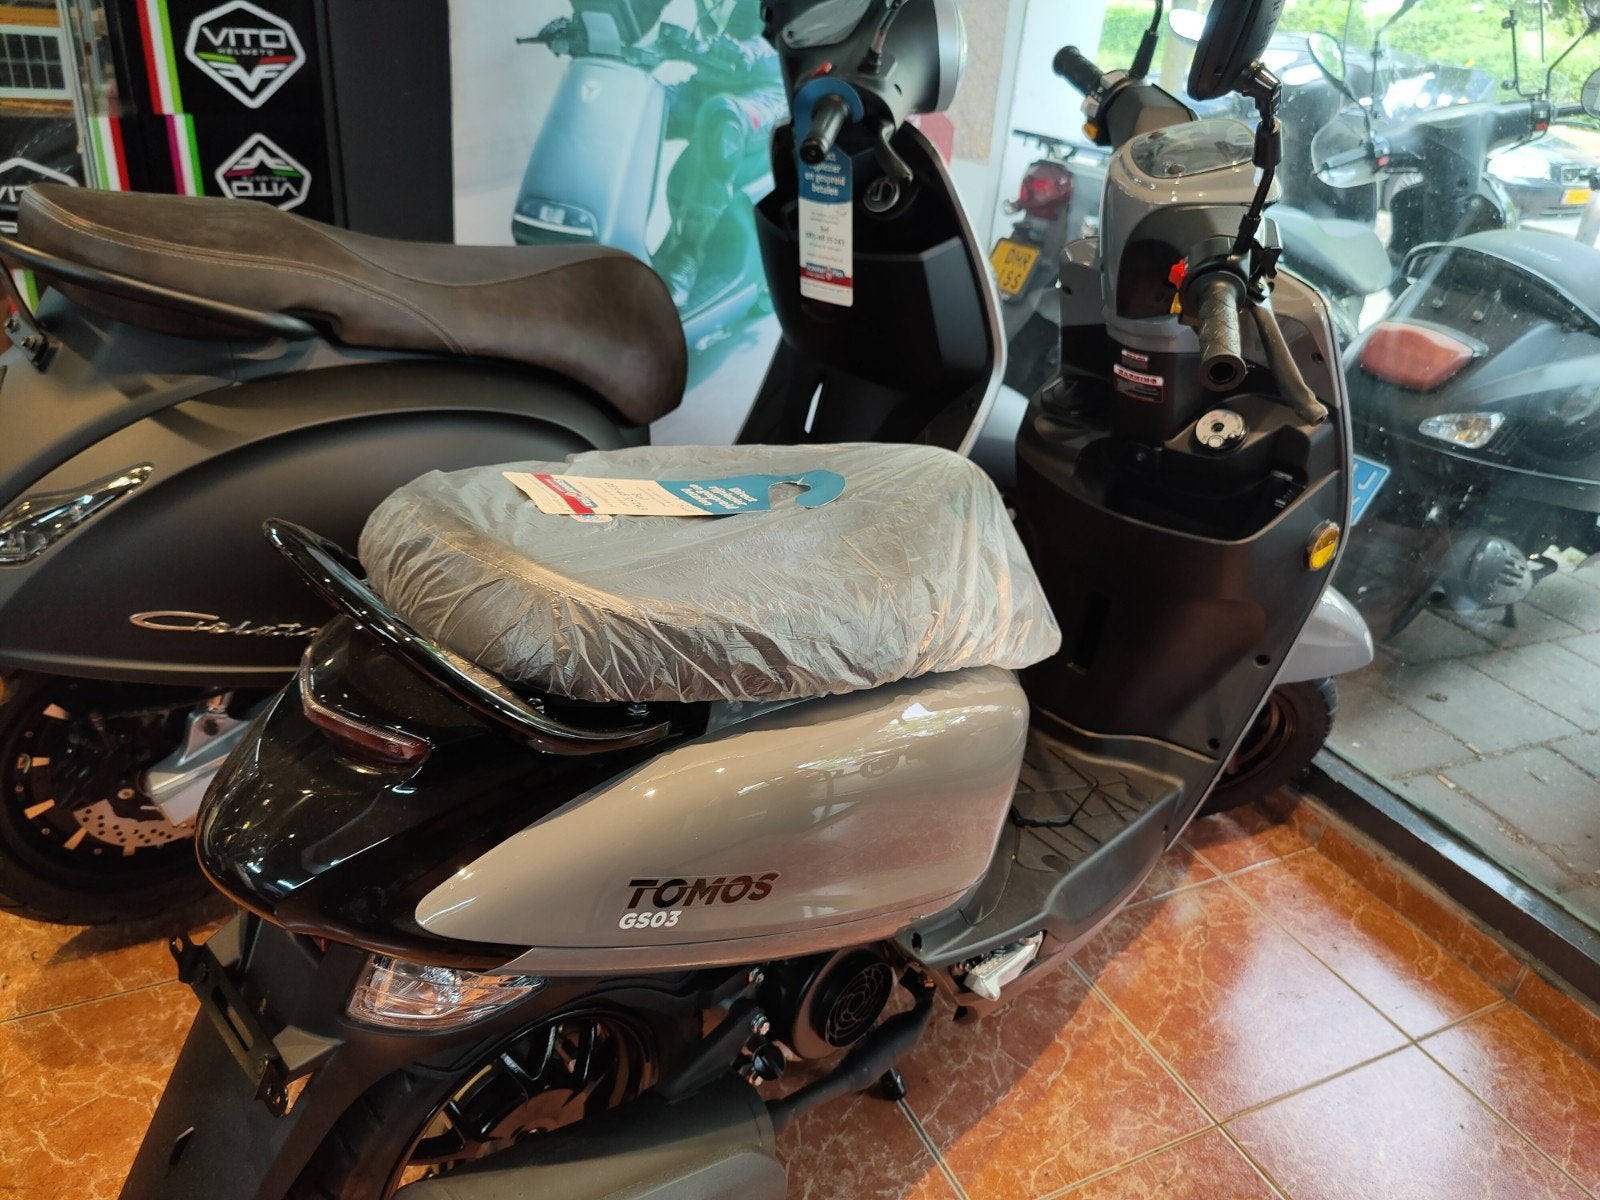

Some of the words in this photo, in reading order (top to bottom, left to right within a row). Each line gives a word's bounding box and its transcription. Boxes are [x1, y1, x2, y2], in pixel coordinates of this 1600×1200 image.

[201, 26, 288, 49] VITO
[217, 48, 275, 56] HELMETS
[231, 181, 300, 197] VITO
[627, 872, 780, 909] TOMOS
[618, 910, 683, 930] GS03
